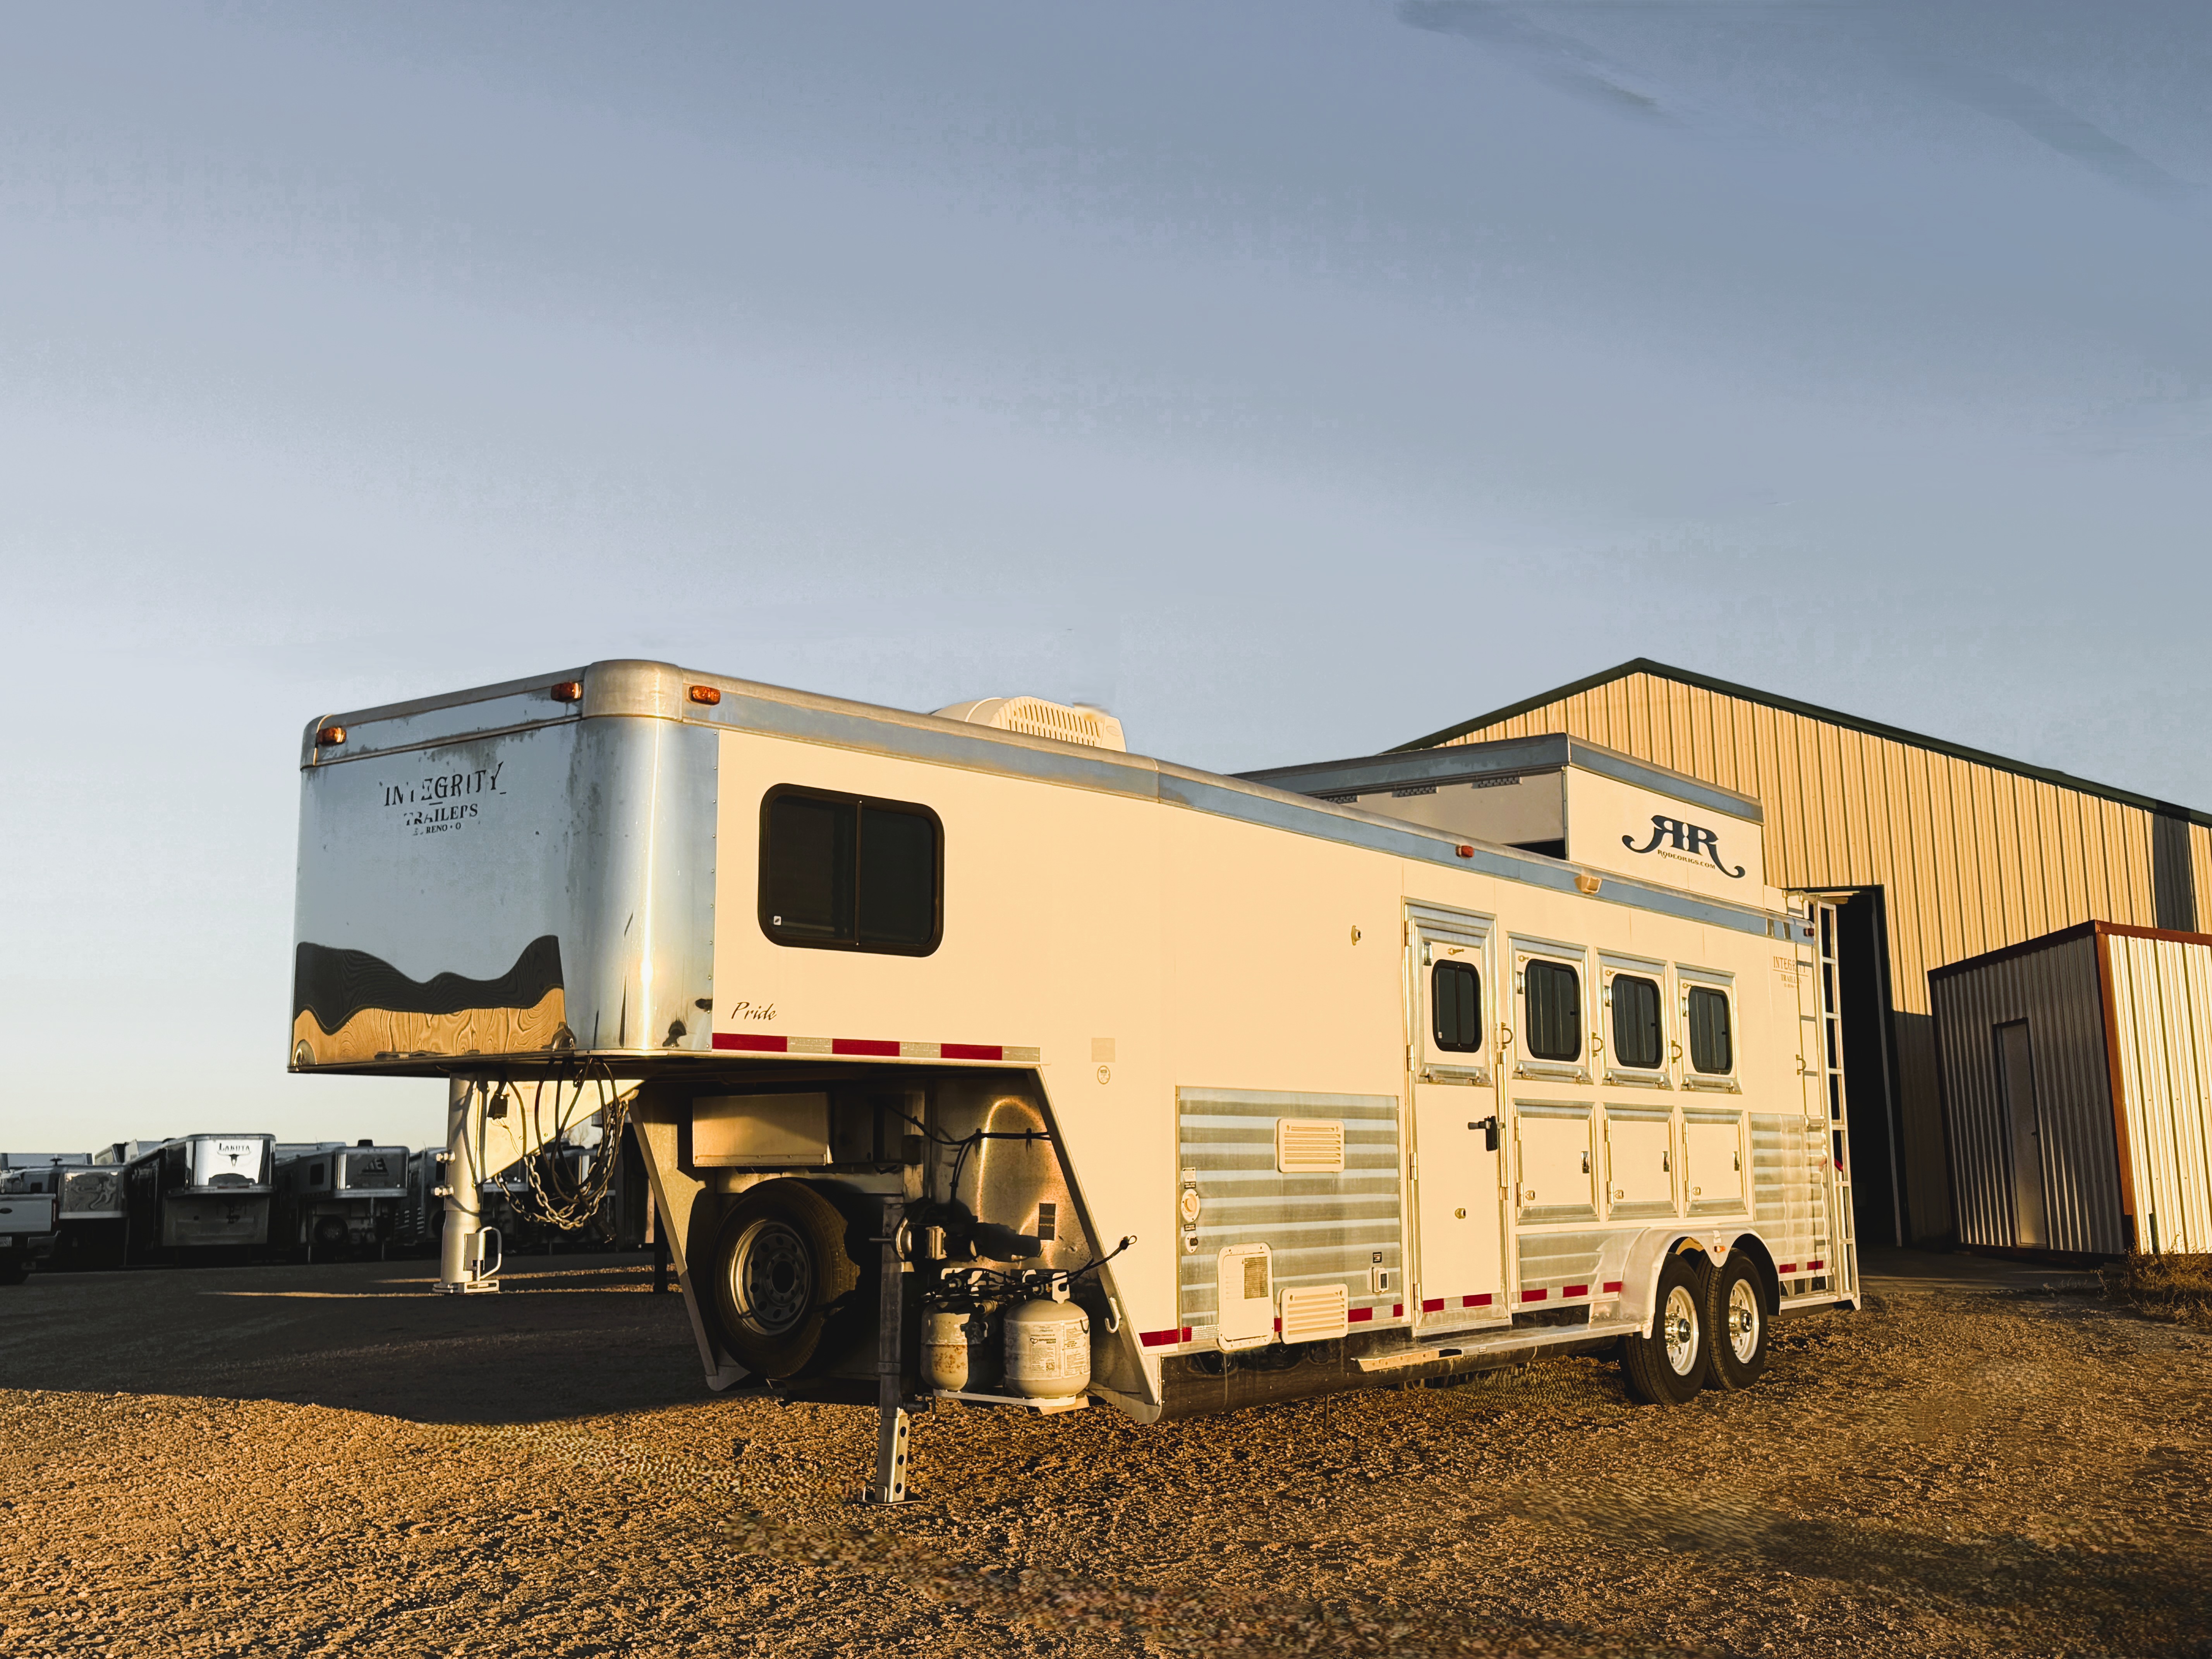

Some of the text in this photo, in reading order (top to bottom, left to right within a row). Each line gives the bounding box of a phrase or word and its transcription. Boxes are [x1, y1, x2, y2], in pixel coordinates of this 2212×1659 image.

[426, 824, 448, 834] RENO
[1773, 956, 1806, 973] INTEGR
[1781, 974, 1802, 984] TRAILES
[731, 1001, 777, 1020] Pride
